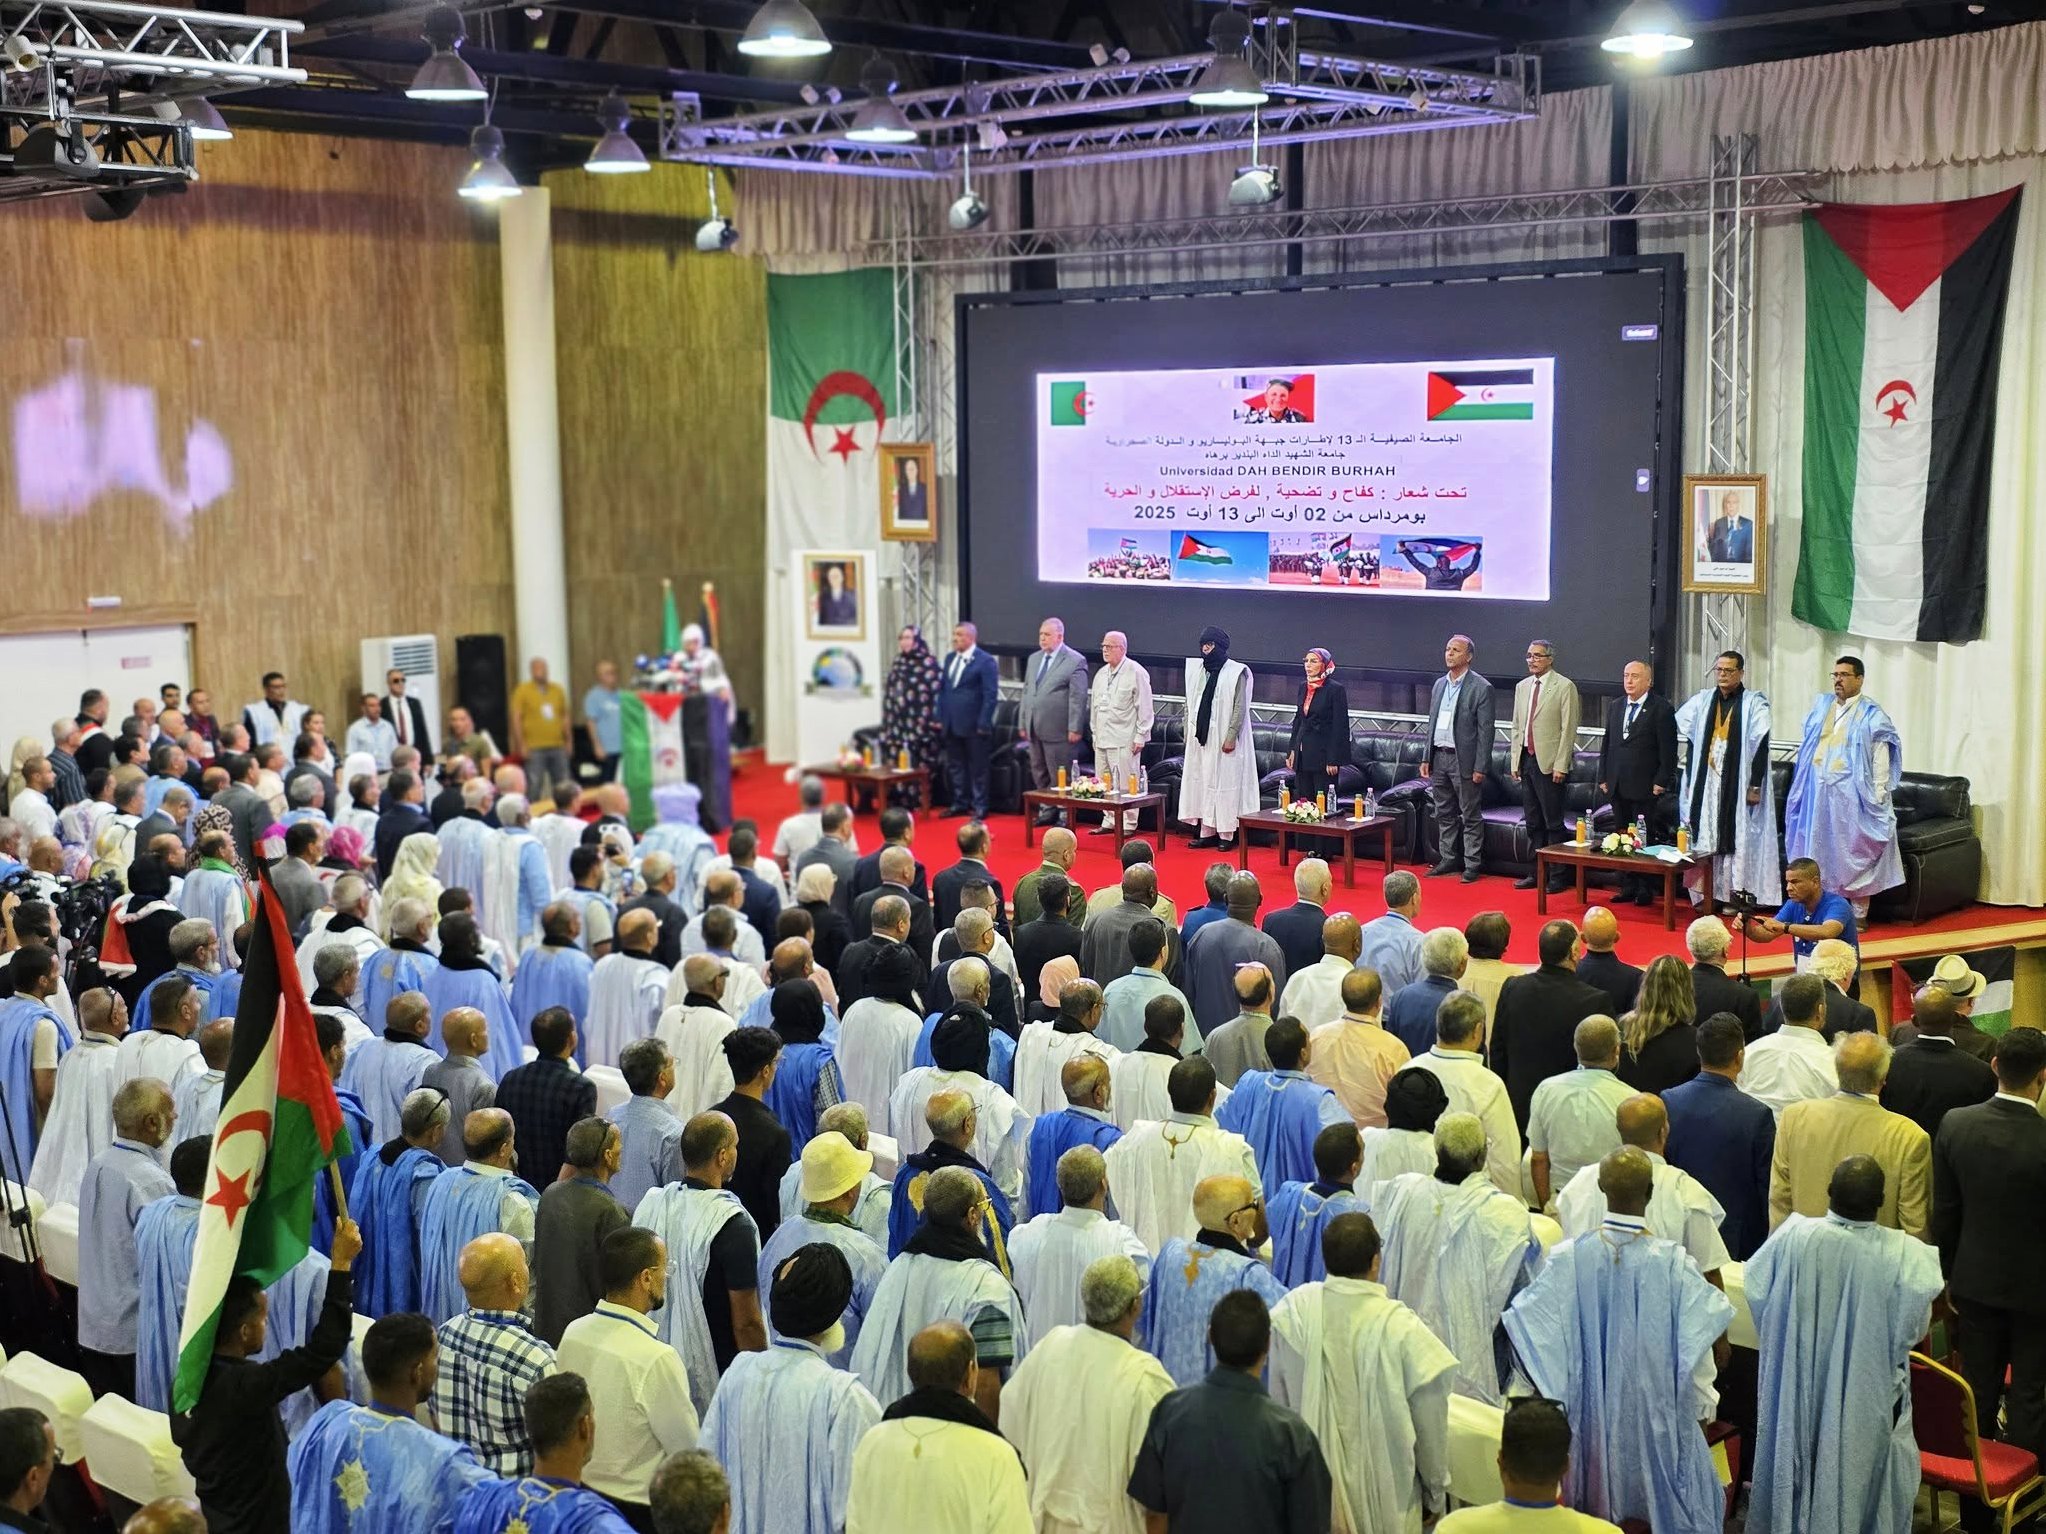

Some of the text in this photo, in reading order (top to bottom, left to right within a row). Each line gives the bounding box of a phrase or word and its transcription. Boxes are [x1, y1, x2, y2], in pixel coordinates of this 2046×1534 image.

[1338, 435, 1352, 445] 13
[1420, 433, 1462, 445] الجامعة
[1318, 448, 1346, 459] جامعة
[1160, 466, 1396, 476] Universidad DAH BENDIR BURHAH
[1104, 483, 1142, 498] الحرية
[1147, 488, 1156, 499] و
[1220, 484, 1260, 499] لفرض
[1276, 483, 1322, 500] تضحية
[1328, 490, 1337, 500] و
[1342, 485, 1374, 502] كفاح
[1393, 485, 1429, 501] شعار
[1434, 487, 1467, 498] تحت
[1134, 506, 1176, 519] 2025
[1219, 507, 1239, 520] 13
[1304, 507, 1326, 521] 02
[1332, 509, 1353, 522] من
[1359, 508, 1426, 524] بومرداس
